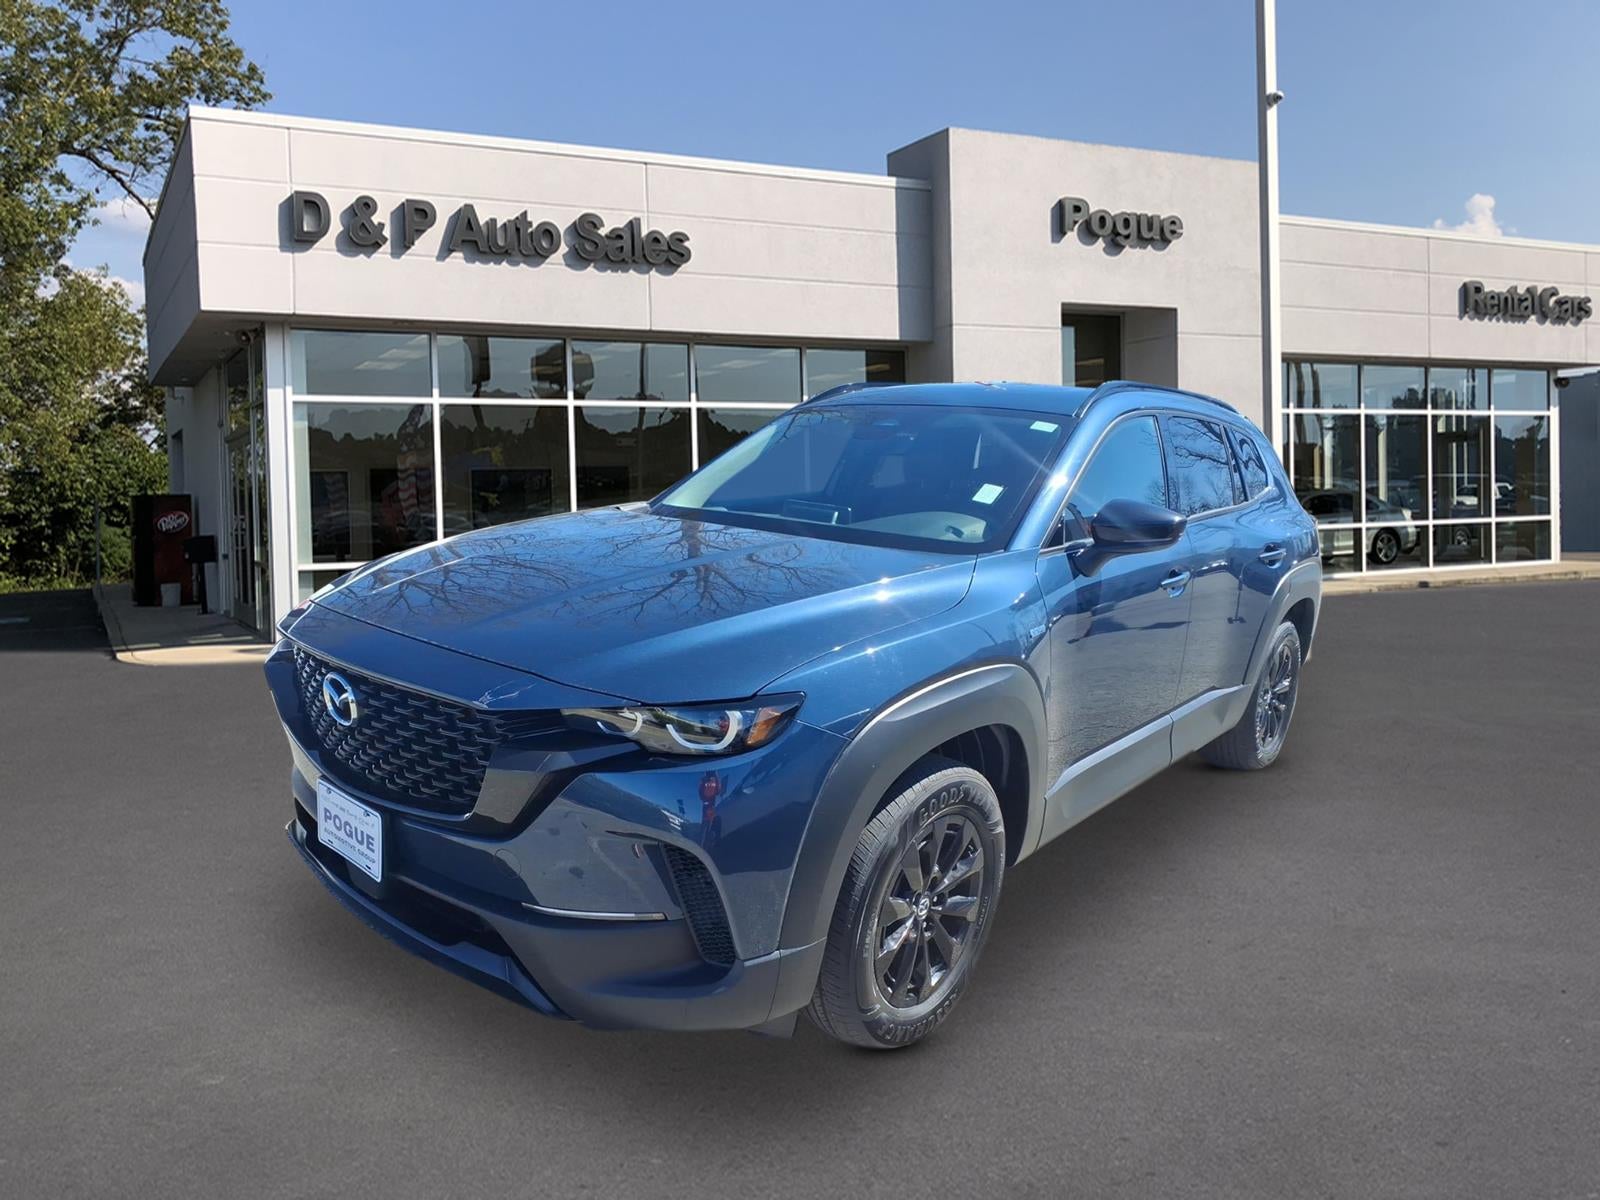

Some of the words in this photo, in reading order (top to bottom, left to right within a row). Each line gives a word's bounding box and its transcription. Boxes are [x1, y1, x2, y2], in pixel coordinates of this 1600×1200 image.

[291, 190, 331, 246] D
[346, 195, 388, 248] &
[402, 198, 436, 248] P
[448, 203, 562, 259] Auto
[573, 212, 692, 268] Sales
[1060, 196, 1184, 247] Pogue
[1464, 280, 1538, 318] Rental
[1540, 286, 1593, 320] Cars
[323, 807, 376, 854] POGUE
